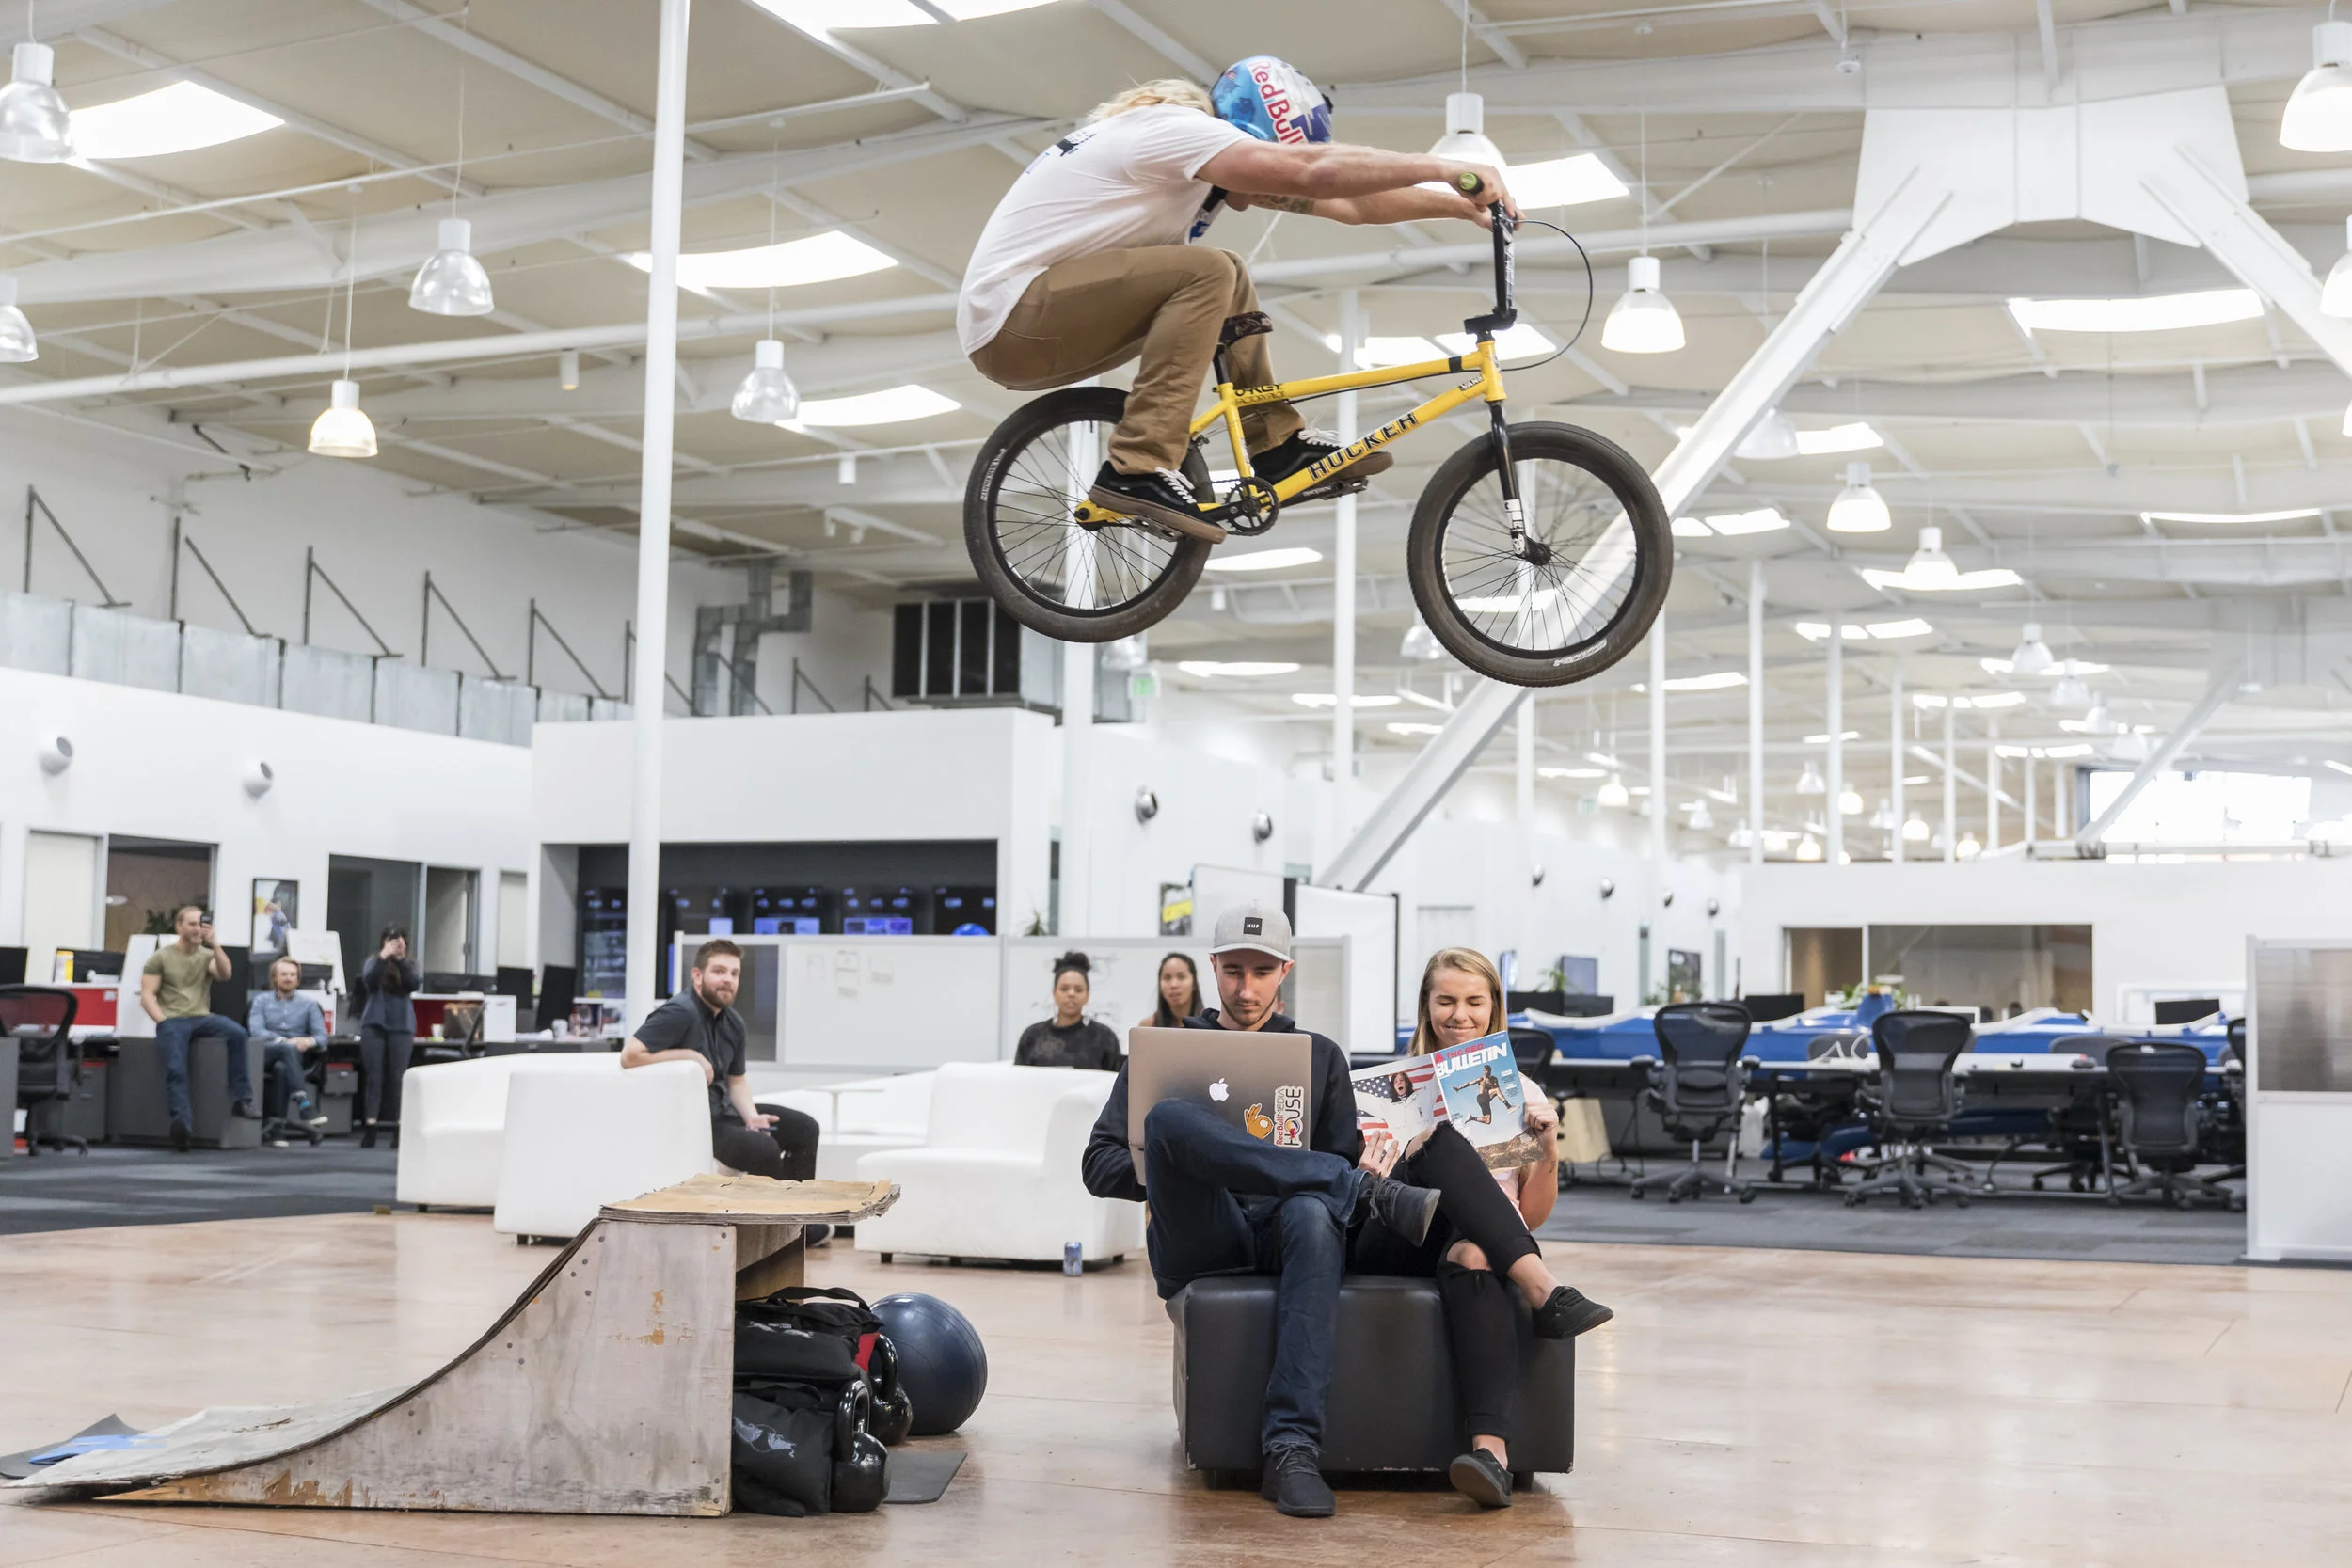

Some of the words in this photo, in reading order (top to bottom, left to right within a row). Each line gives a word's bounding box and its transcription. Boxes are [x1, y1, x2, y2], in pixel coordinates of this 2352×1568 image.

[1248, 61, 1285, 100] Red
[1267, 99, 1303, 145] Bull
[1446, 1049, 1462, 1059] THE
[1464, 1043, 1484, 1054] RED
[1284, 1089, 1301, 1145] HOUSE
